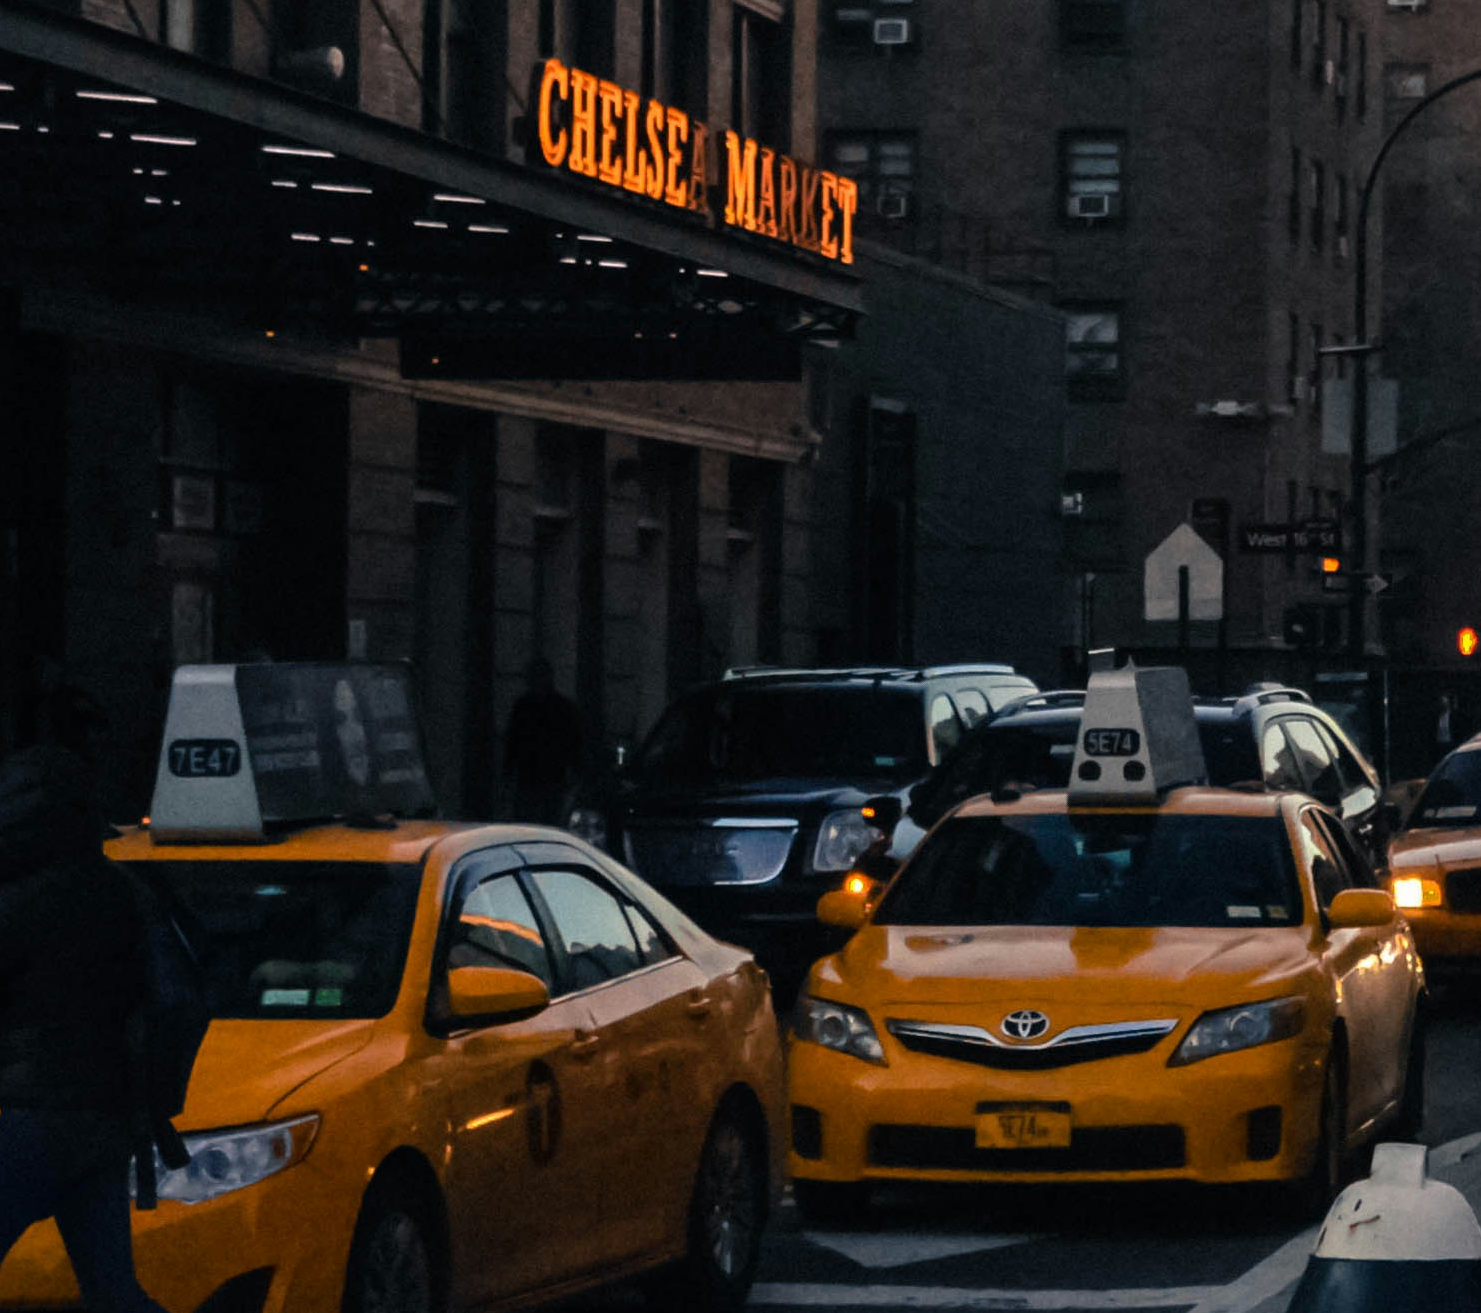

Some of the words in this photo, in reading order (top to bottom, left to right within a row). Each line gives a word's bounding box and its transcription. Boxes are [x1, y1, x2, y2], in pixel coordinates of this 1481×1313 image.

[537, 56, 713, 219] CHELSEA
[723, 128, 860, 266] MARKET
[1246, 531, 1288, 548] West
[173, 745, 237, 774] 7E47
